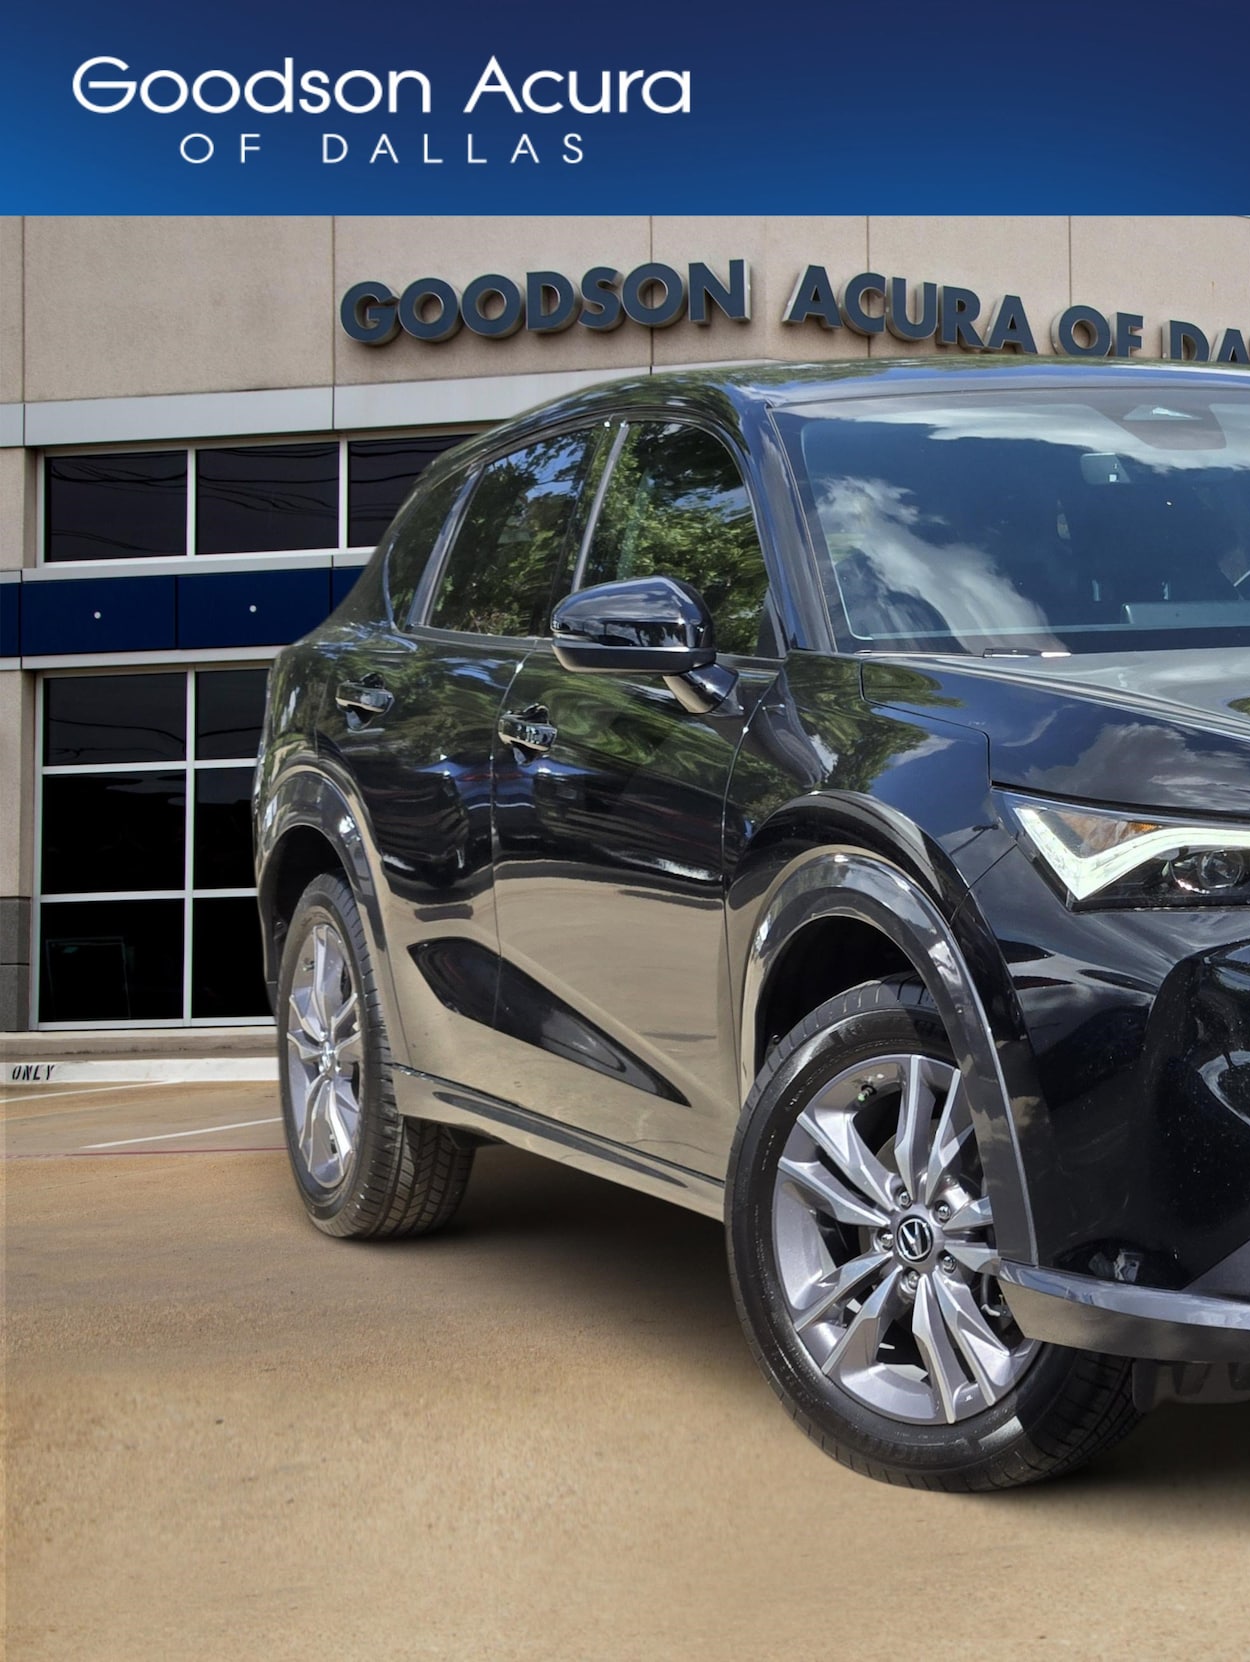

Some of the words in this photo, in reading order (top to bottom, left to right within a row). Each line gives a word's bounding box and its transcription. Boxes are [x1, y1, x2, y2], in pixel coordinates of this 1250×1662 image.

[340, 259, 751, 347] GOODSON
[783, 264, 1037, 354] ACURA
[1051, 304, 1144, 357] OF
[12, 1064, 55, 1081] ONLY
